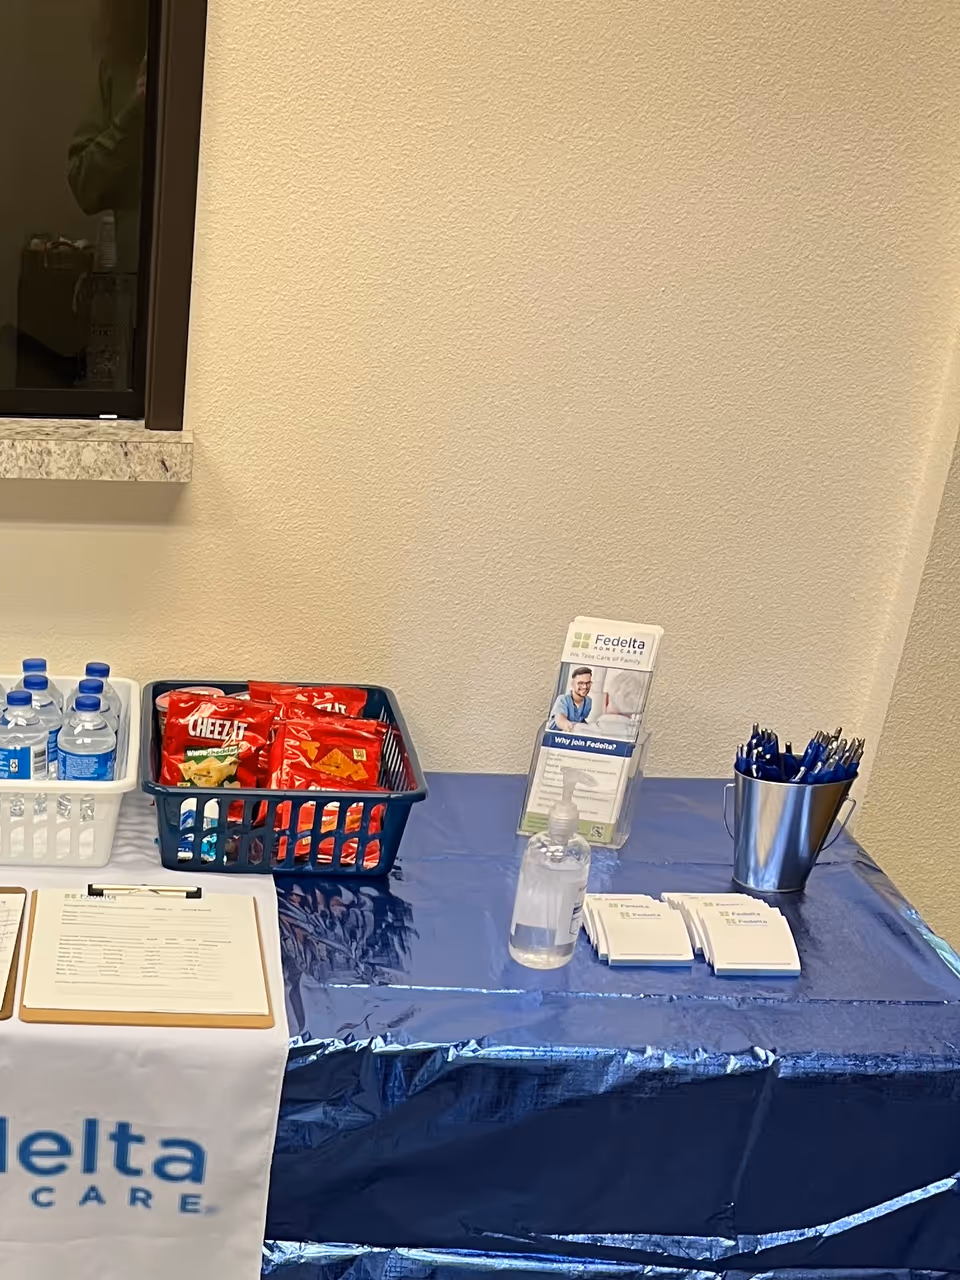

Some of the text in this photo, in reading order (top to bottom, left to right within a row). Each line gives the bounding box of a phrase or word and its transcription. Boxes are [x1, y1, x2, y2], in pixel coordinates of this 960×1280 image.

[595, 634, 646, 650] Fedelta
[554, 736, 617, 750] Why join Fedelta?
[30, 1185, 203, 1215] CARE
